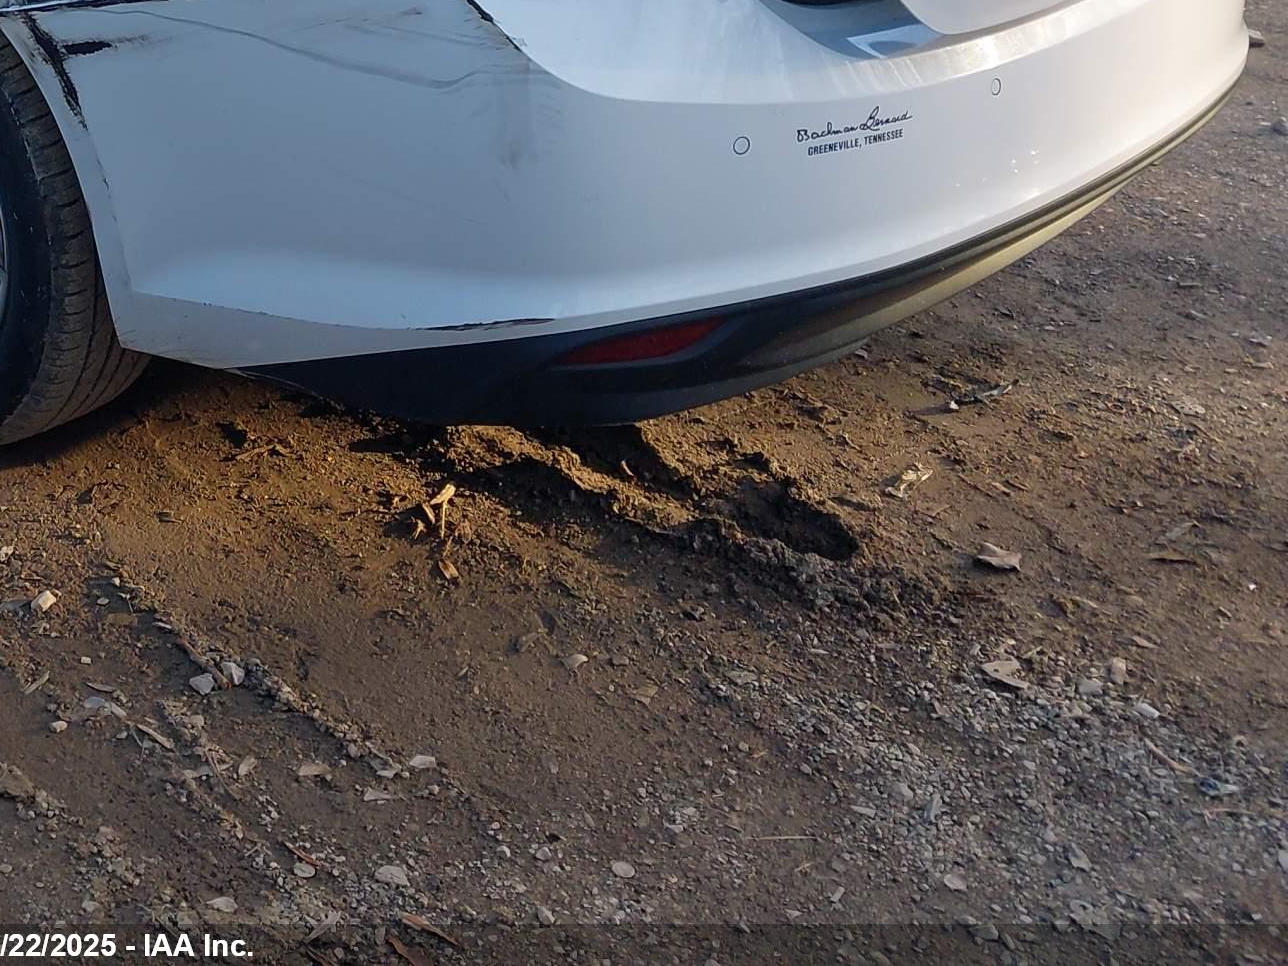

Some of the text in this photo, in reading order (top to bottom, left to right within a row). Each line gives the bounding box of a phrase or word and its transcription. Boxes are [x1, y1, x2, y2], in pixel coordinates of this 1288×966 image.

[796, 121, 859, 143] Bachman
[807, 128, 904, 156] GREENEVILLE, TENNESSEE
